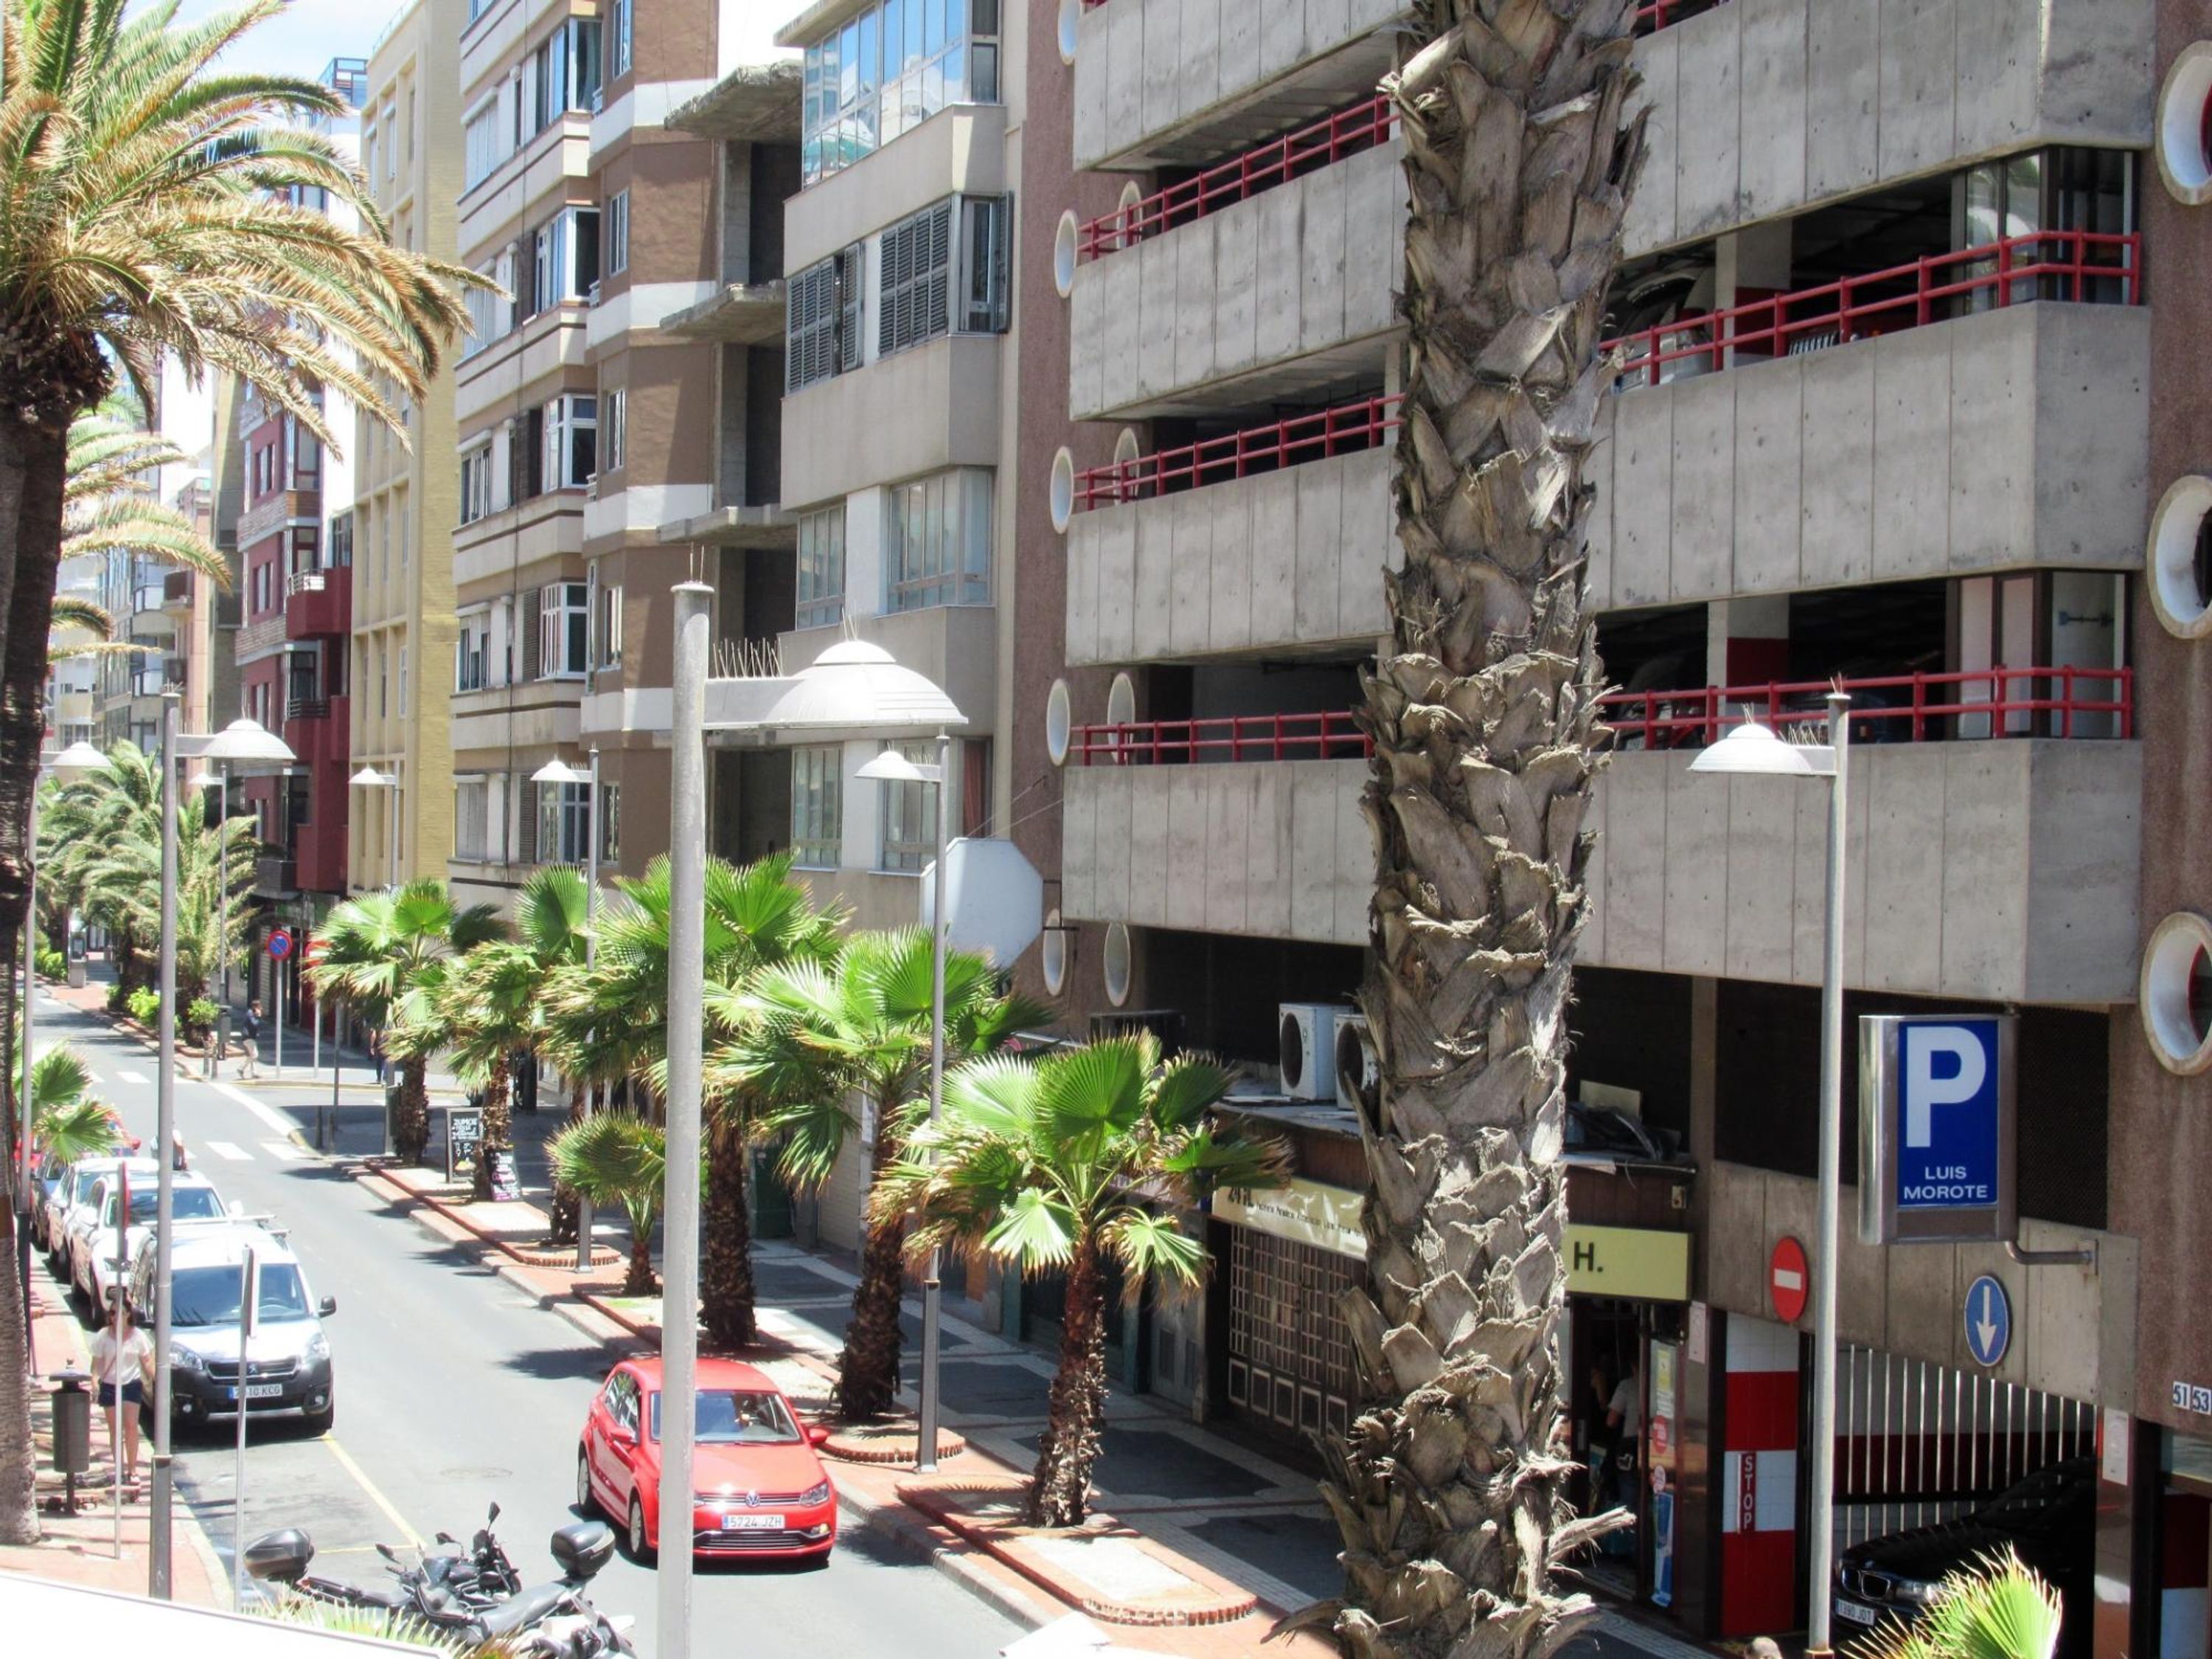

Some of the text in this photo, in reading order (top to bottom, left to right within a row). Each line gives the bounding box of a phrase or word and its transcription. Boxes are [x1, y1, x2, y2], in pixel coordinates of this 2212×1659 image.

[1906, 1026, 1986, 1148] P
[1924, 1166, 1967, 1180] LUIS
[1903, 1184, 1988, 1200] MOROTE
[1573, 1241, 1604, 1273] H.
[2172, 1385, 2210, 1412] 51 53
[1742, 1455, 1753, 1531] STOP
